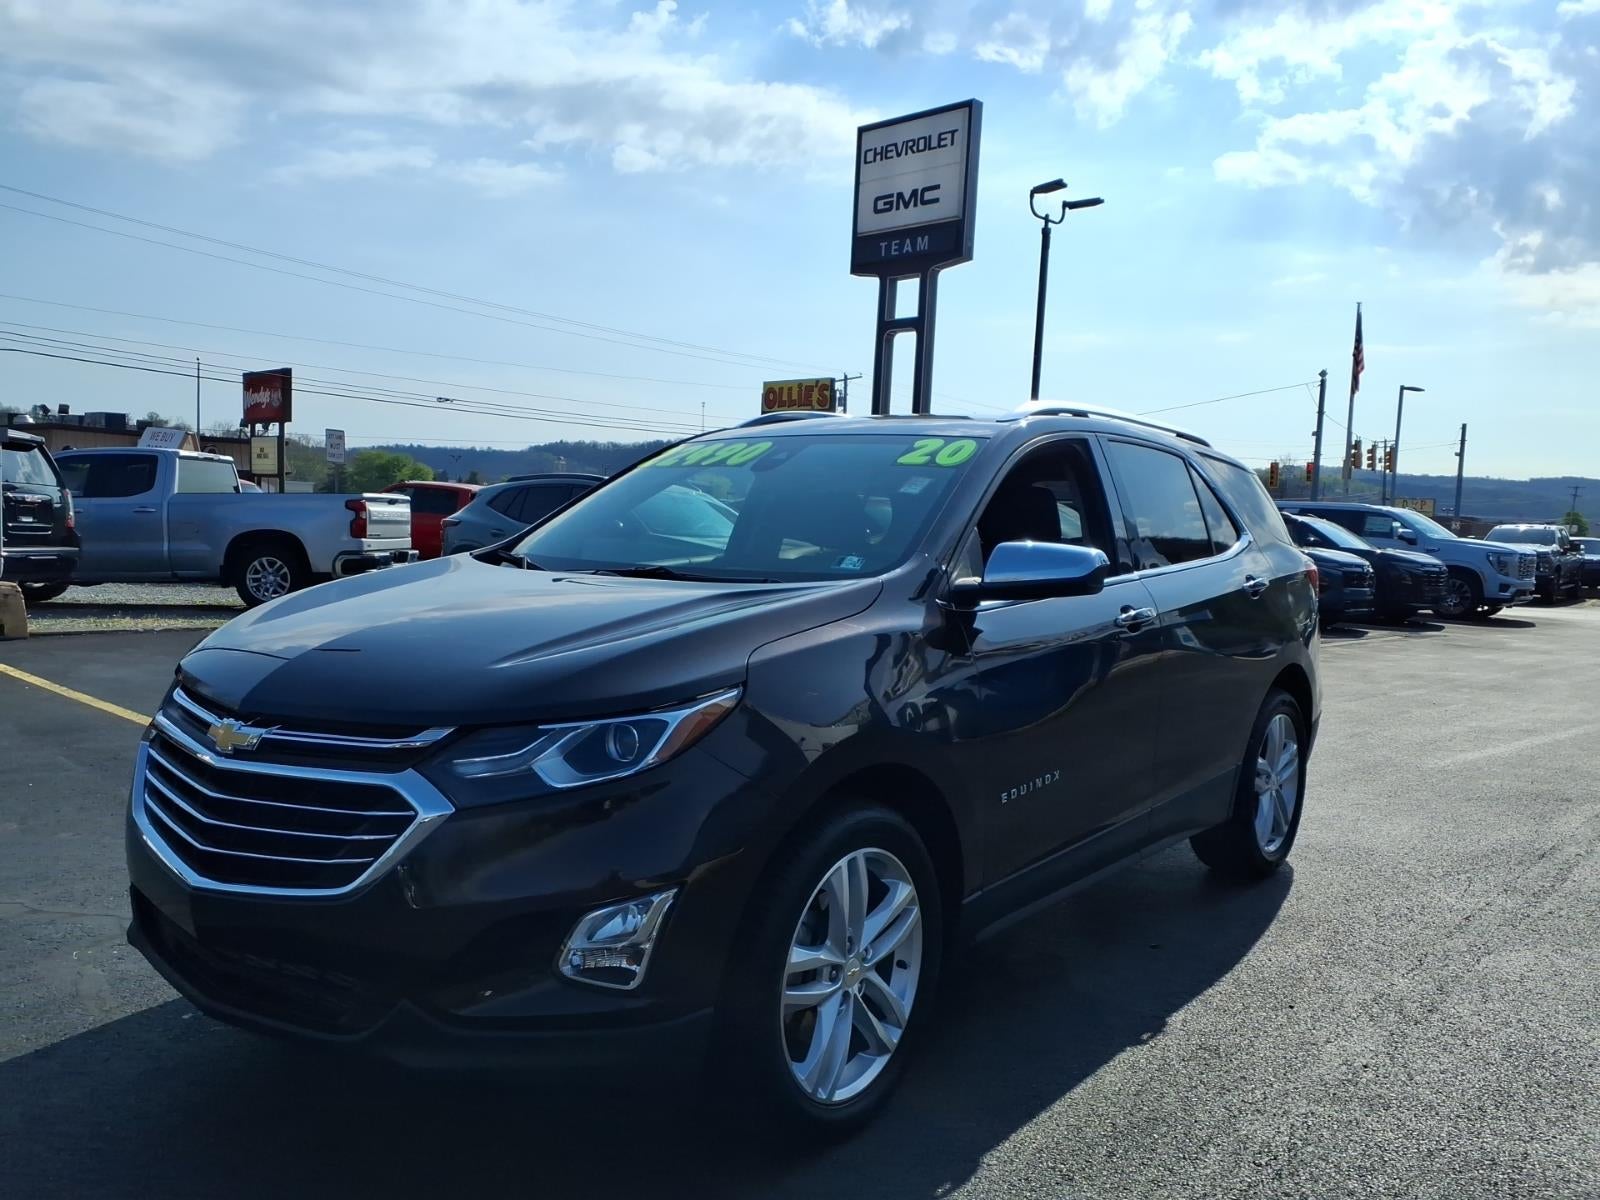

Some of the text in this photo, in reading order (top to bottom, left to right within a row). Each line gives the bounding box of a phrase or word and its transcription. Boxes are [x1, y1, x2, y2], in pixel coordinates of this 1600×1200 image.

[863, 128, 959, 165] CHEVROLET
[873, 183, 941, 215] GMC
[880, 235, 929, 257] TEAM
[896, 438, 978, 467] 20
[1001, 769, 1061, 804] EQUINOX
